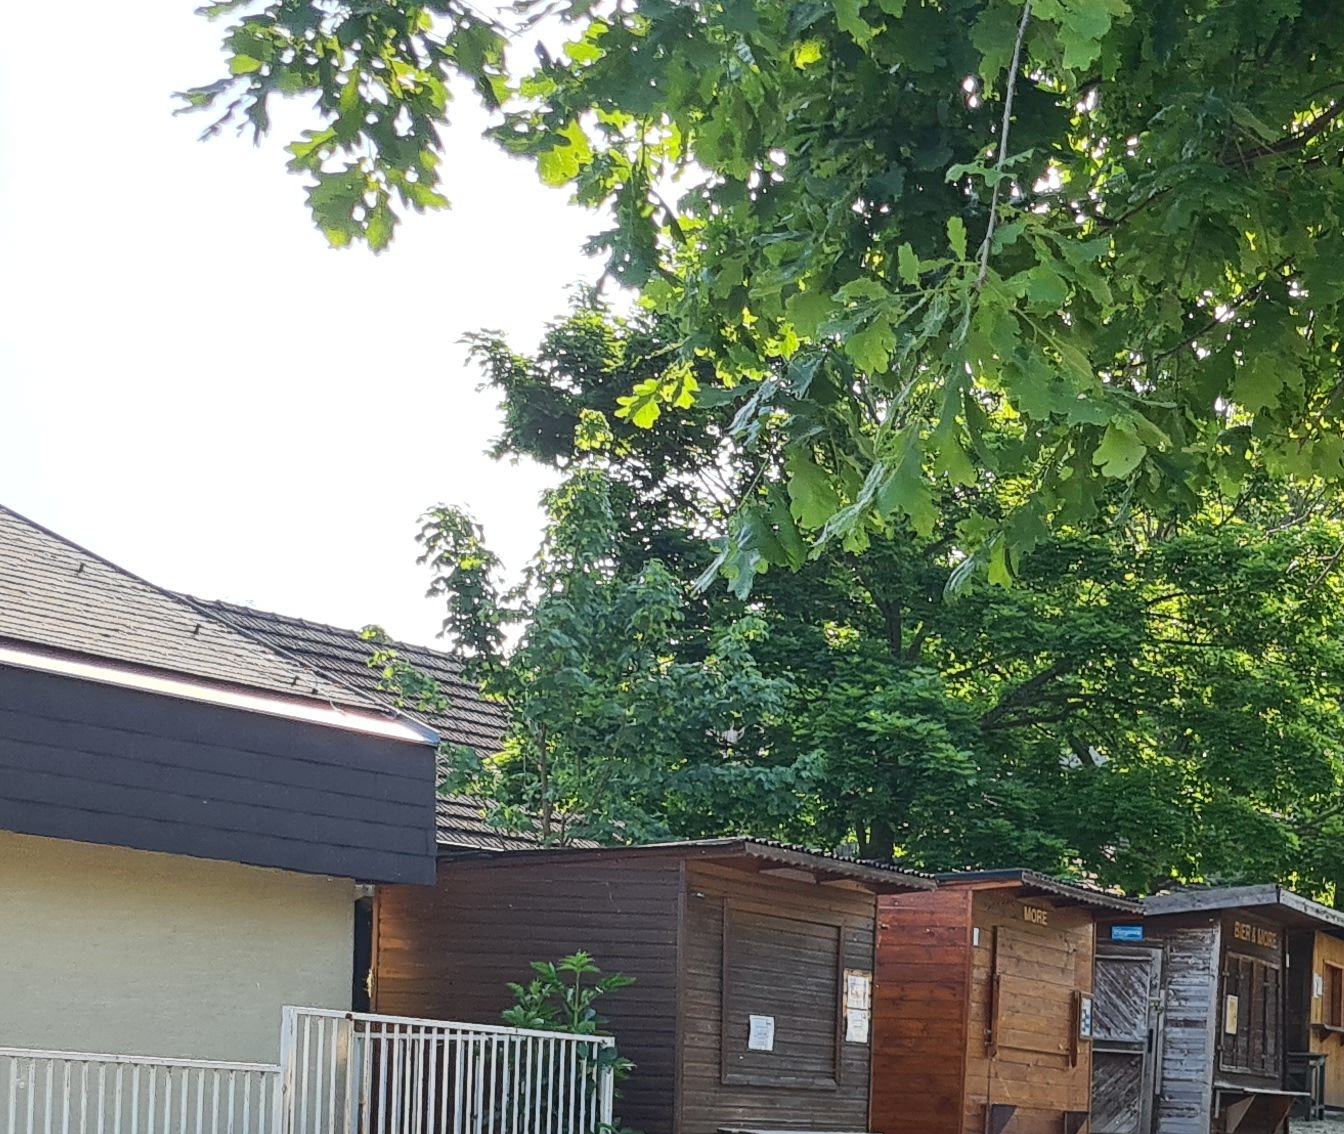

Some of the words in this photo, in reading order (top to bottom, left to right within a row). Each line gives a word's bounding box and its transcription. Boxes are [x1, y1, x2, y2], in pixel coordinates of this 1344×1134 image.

[1023, 906, 1048, 926] MORE
[1234, 920, 1251, 941] BIER
[1257, 928, 1278, 950] MORE
